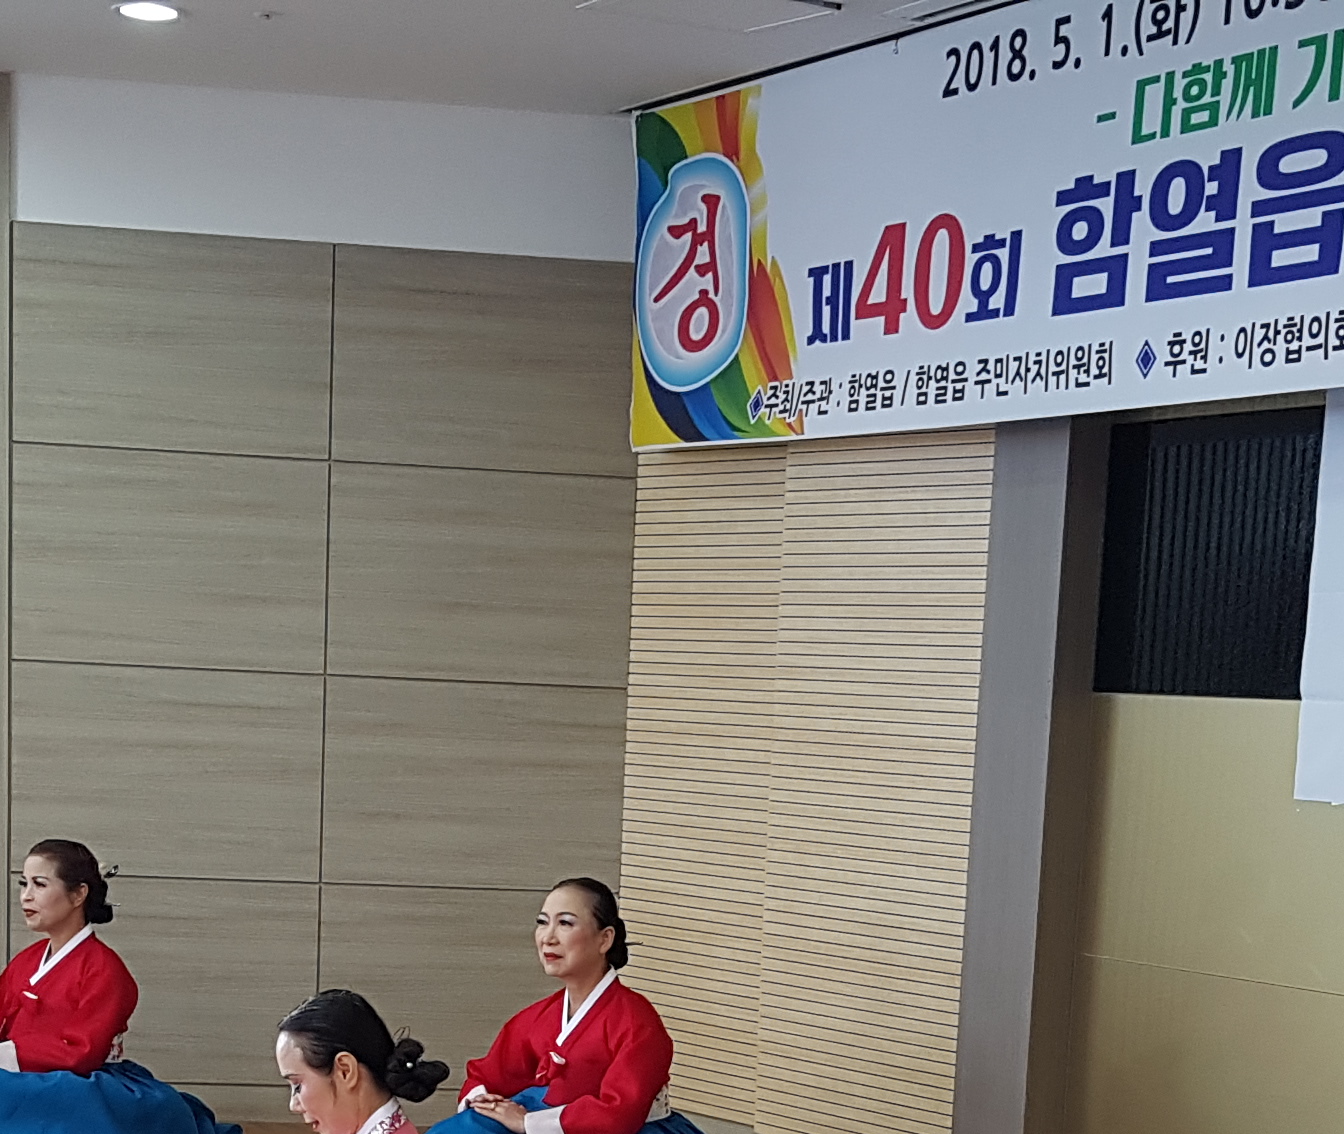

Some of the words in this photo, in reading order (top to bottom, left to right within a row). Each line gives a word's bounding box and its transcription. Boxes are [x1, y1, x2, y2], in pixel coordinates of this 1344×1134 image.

[942, 27, 1037, 99] 2018.
[1051, 13, 1082, 71] 5.
[1131, 44, 1280, 146] 다함께
[653, 192, 722, 353] 경
[805, 211, 1024, 347] 제40회
[763, 376, 834, 421] 주최/주관
[846, 366, 897, 414] 함열읍
[914, 359, 969, 407] 함열읍
[973, 340, 1114, 400] 주민자치위원회
[1162, 326, 1212, 380] 후원
